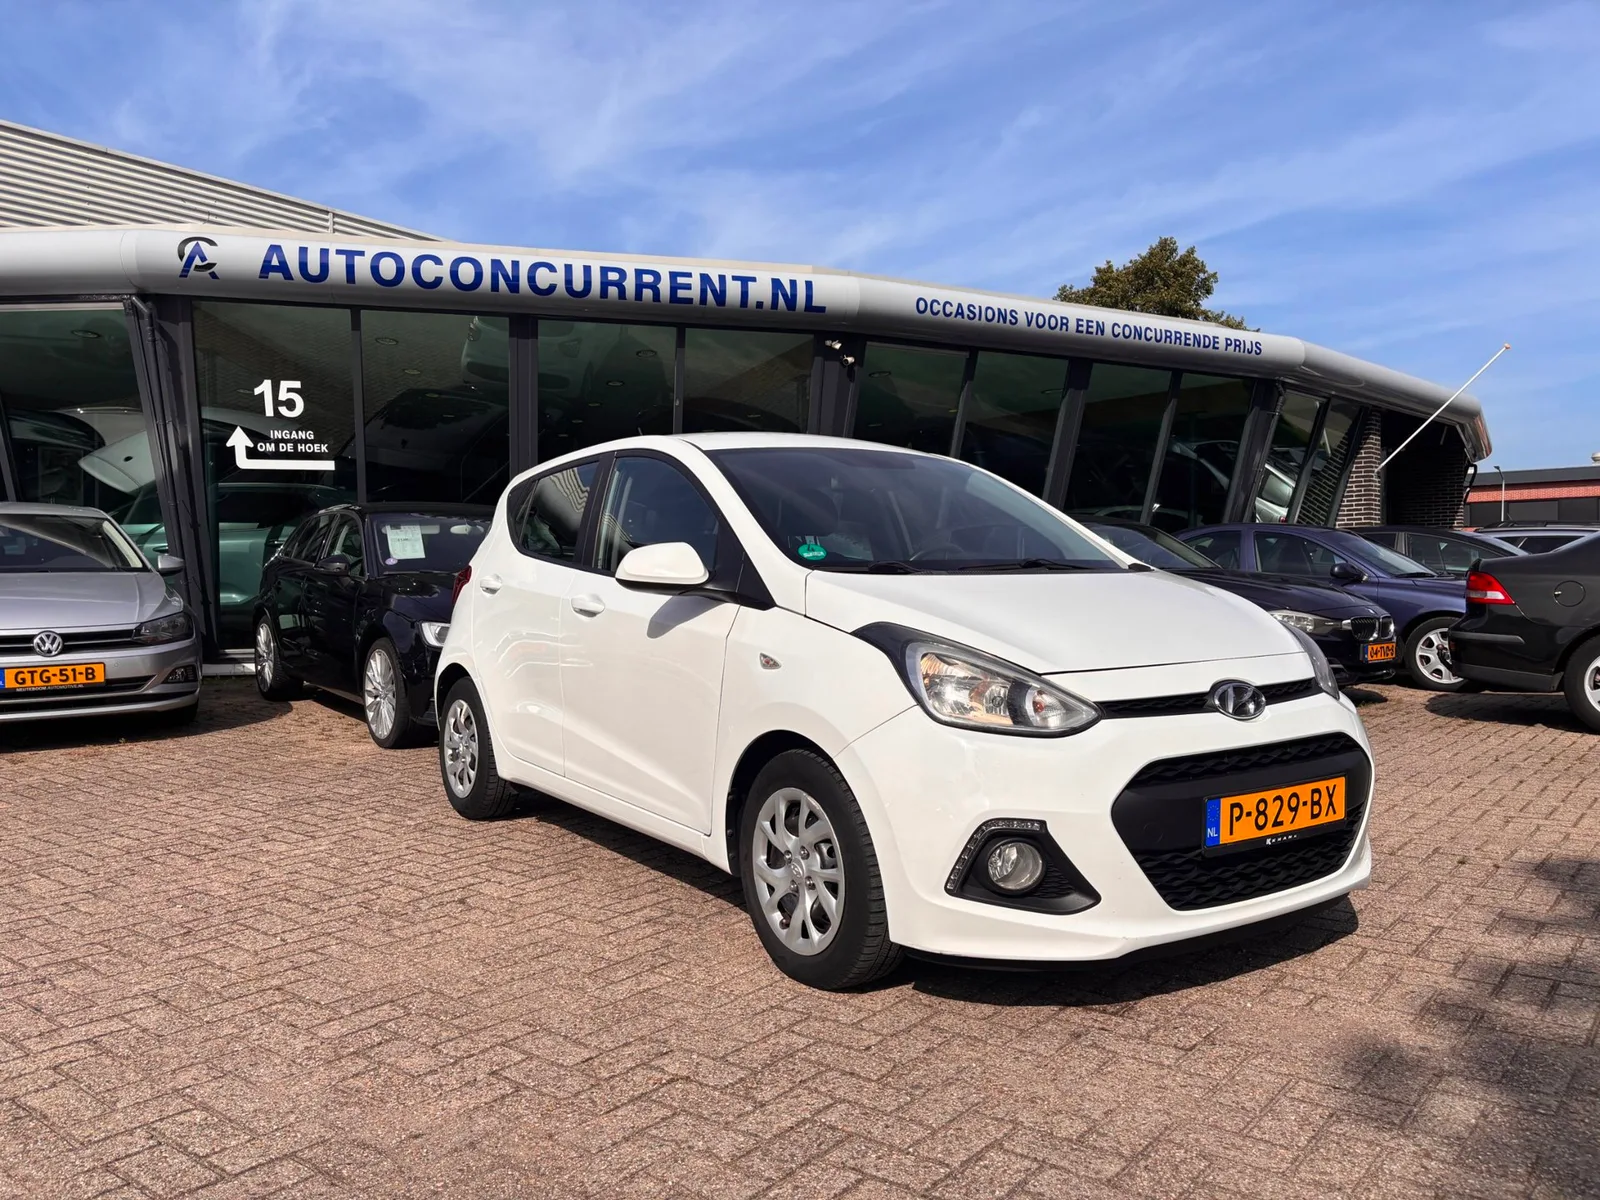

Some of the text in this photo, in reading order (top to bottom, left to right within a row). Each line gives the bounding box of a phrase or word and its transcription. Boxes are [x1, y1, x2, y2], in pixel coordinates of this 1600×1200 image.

[258, 244, 827, 314] AUTOCONCURRENT.NL
[915, 297, 1262, 356] OCCASIONS VOOR EEN CONCURRENDE PRIJS
[254, 379, 305, 418] 15
[257, 443, 329, 453] OM DE HOEK
[270, 430, 315, 440] INGANG
[14, 667, 96, 685] GTG-51-B
[1229, 784, 1337, 836] P-829-BX
[1207, 827, 1219, 838] NL
